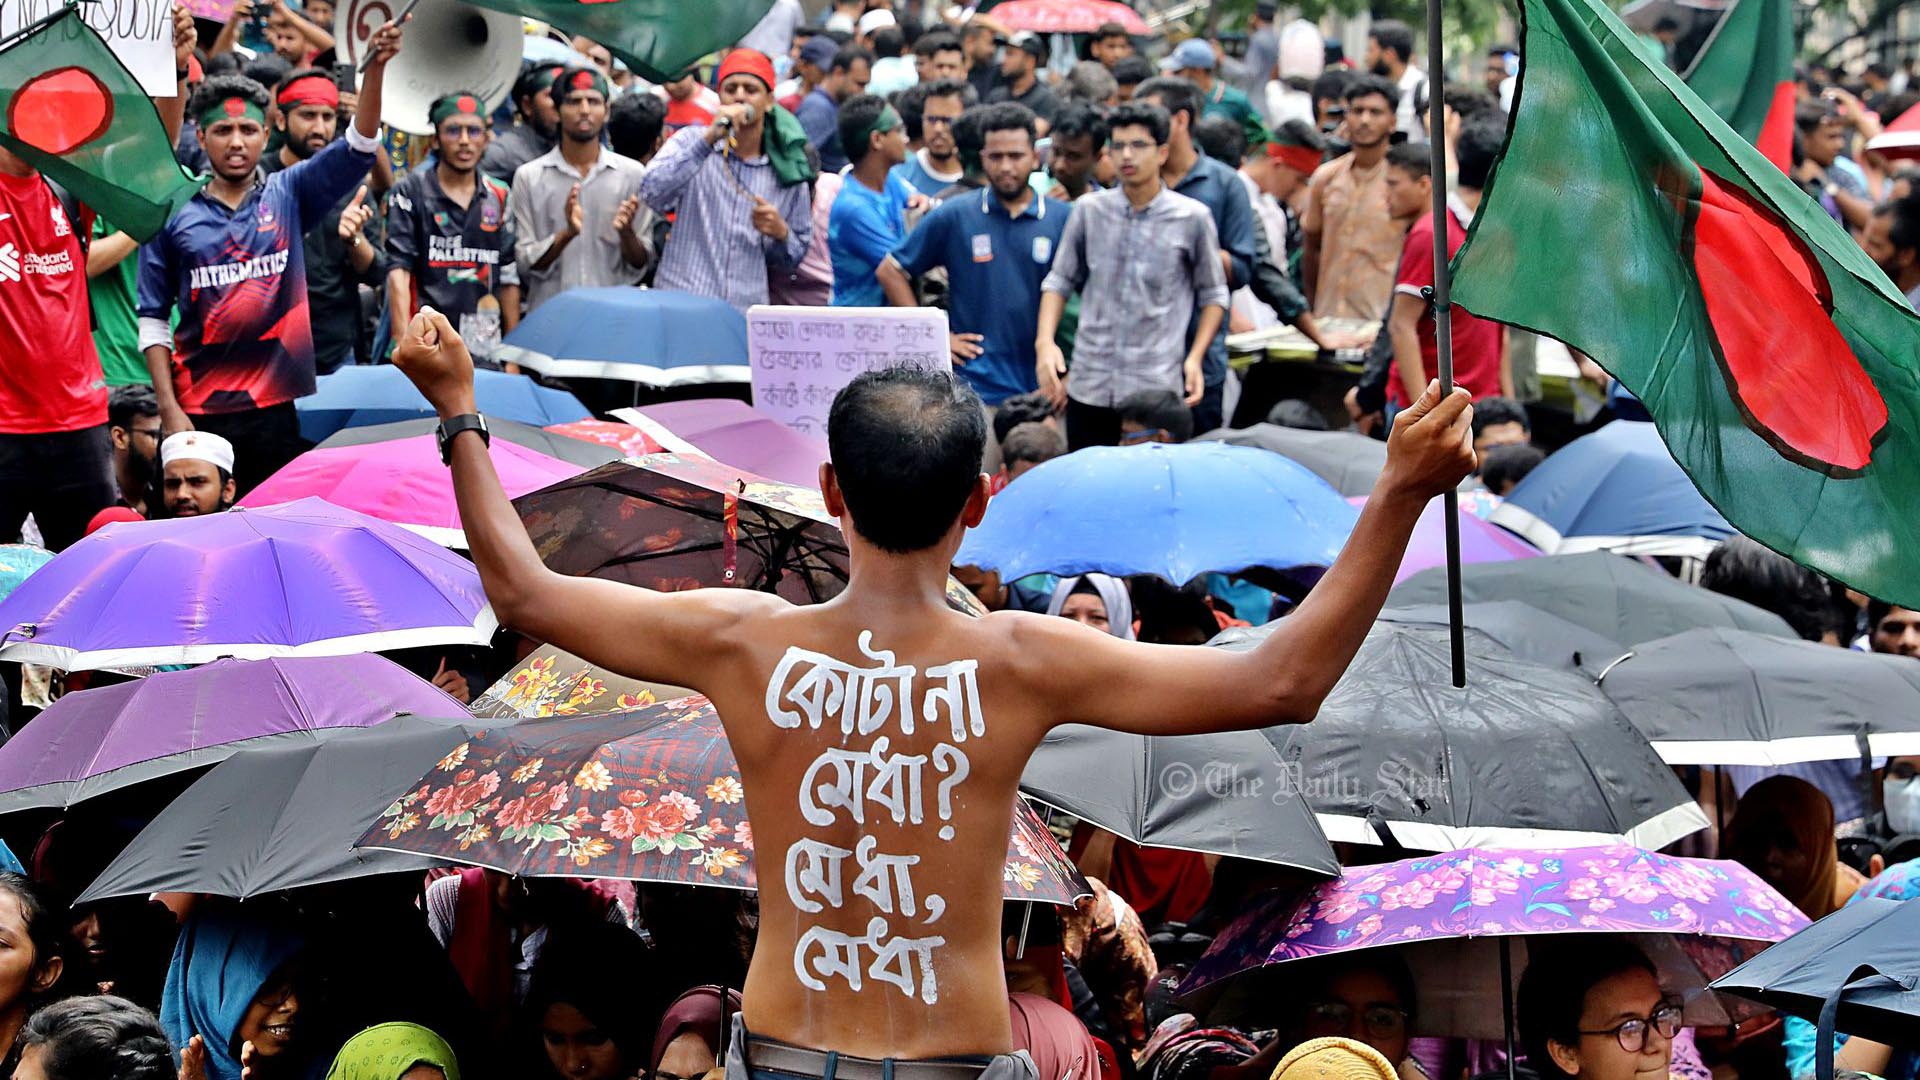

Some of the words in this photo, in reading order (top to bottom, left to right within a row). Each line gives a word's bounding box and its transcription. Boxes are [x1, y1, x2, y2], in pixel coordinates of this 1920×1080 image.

[428, 247, 500, 264] PALESTINE
[429, 235, 462, 249] FREE
[765, 630, 916, 736] কোটা
[923, 659, 985, 742] না
[793, 916, 945, 1005] মেধা
